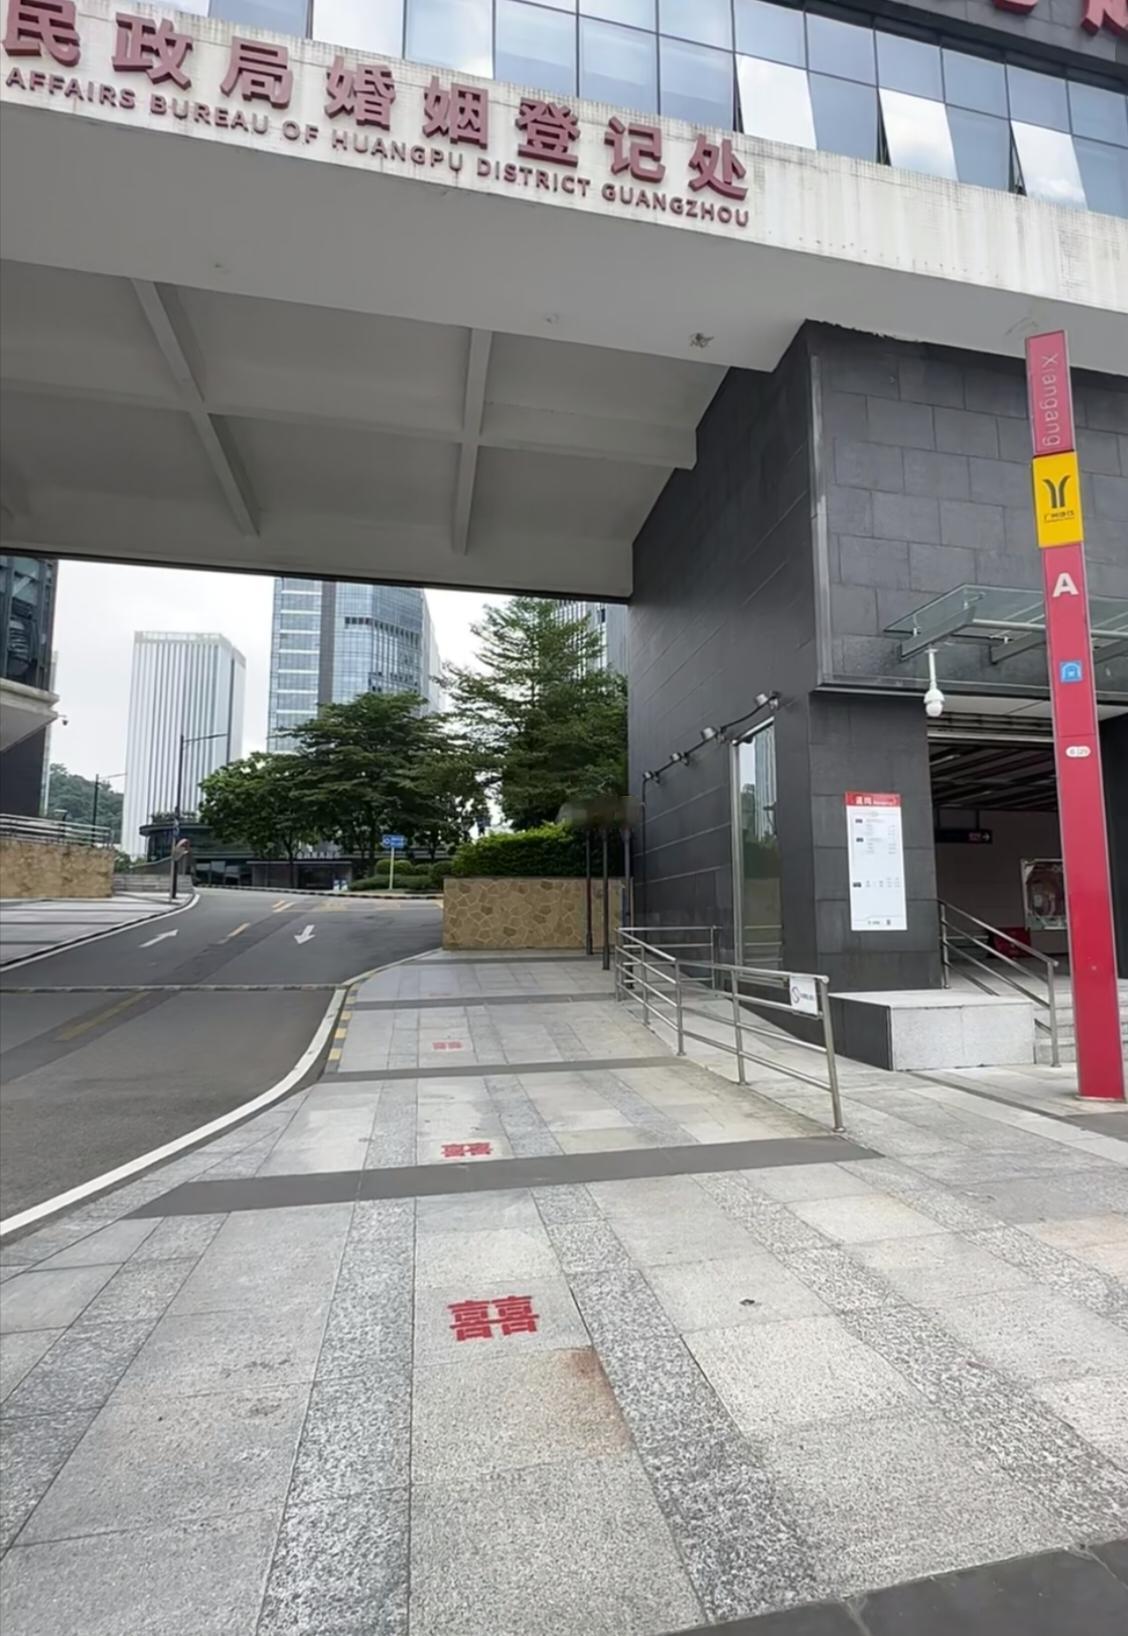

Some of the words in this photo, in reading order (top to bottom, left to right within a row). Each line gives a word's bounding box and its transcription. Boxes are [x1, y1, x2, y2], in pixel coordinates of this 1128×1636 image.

[3, 0, 748, 201] 民政局婚姻登记处
[6, 66, 136, 110] AFFAIRS
[150, 94, 269, 135] BUREAU
[281, 120, 319, 145] OF
[331, 128, 463, 173] HUANGPU
[476, 157, 591, 198] DISTRICT
[601, 182, 750, 228] GUANGZHOU
[1052, 572, 1079, 598] A
